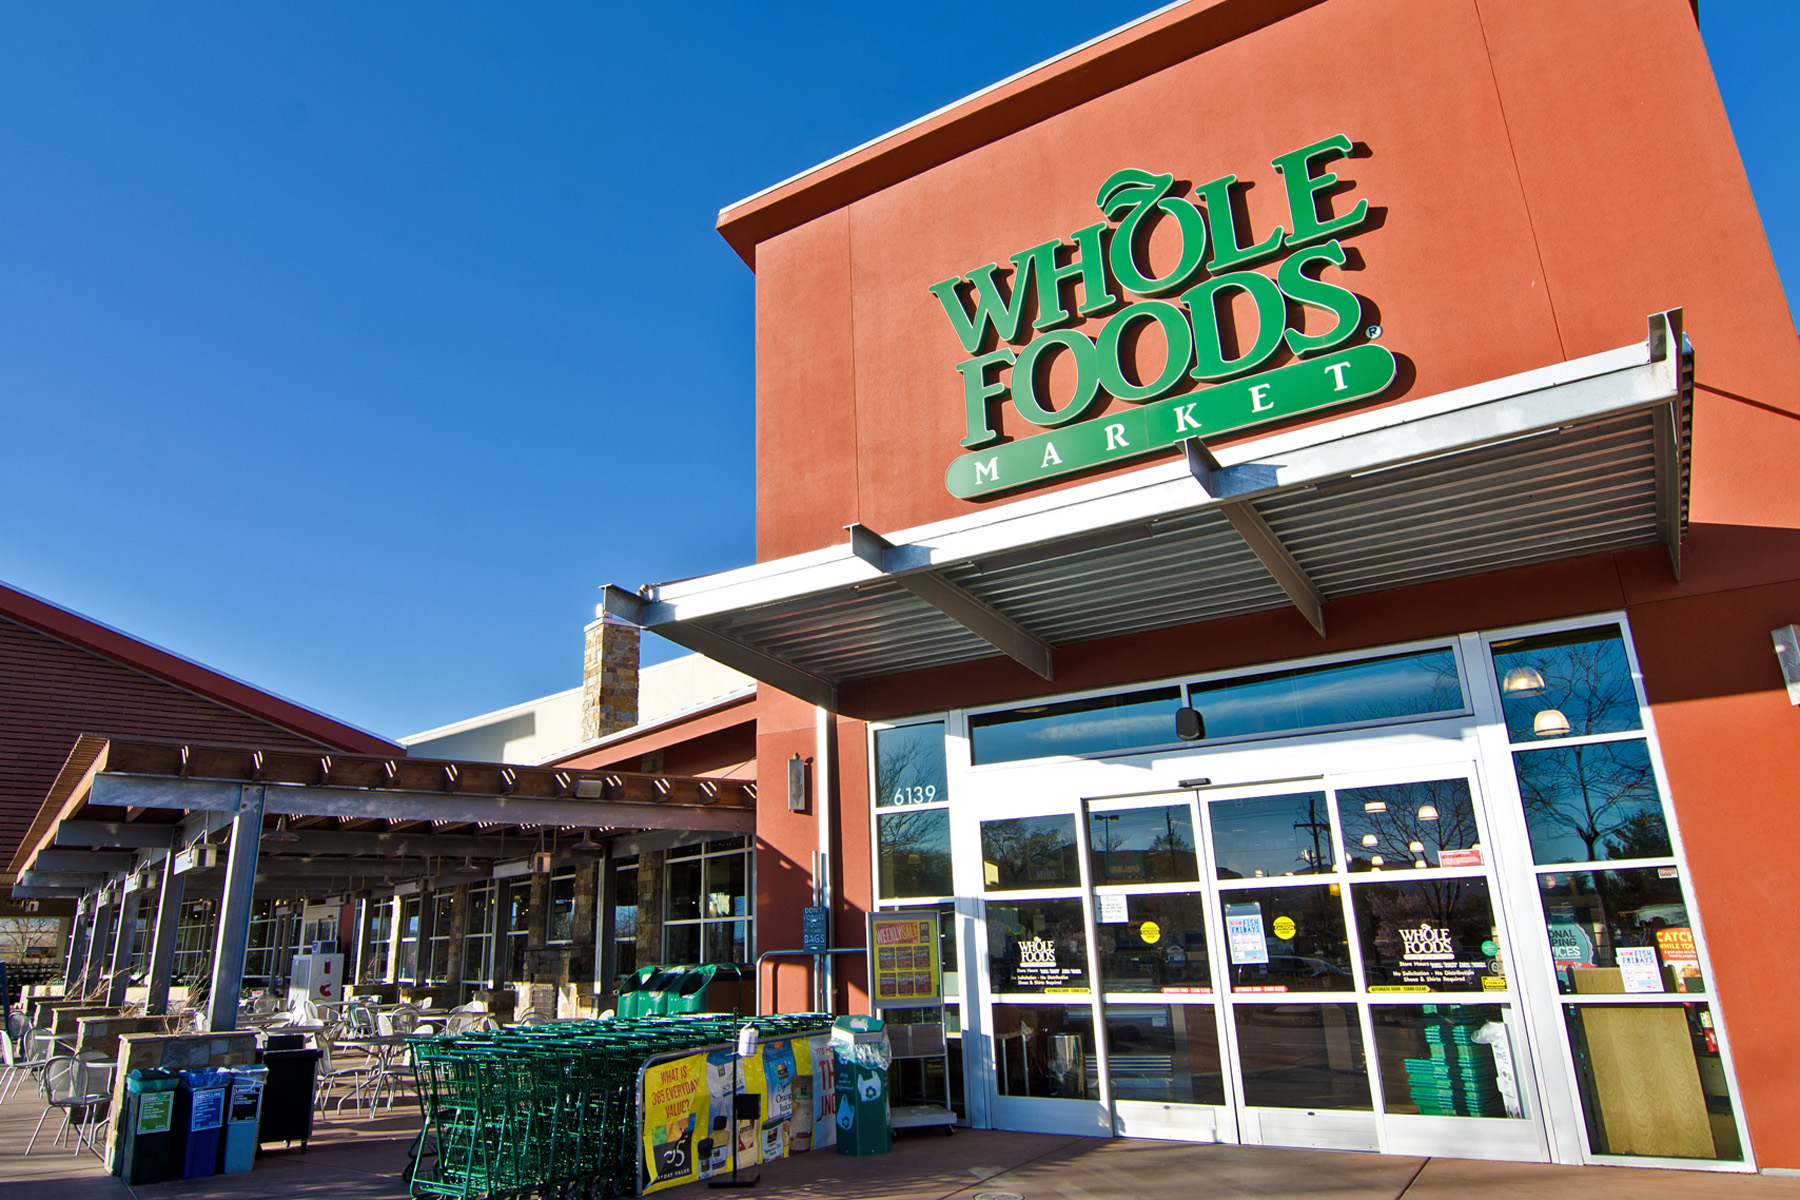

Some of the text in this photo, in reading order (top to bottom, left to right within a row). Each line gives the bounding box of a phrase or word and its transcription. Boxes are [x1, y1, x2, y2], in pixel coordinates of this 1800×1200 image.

[929, 133, 1369, 354] WHOLE
[956, 239, 1362, 449] FOODS
[974, 360, 1352, 486] MARKET
[893, 784, 936, 806] 6139
[1231, 926, 1260, 934] FRIDAYS
[1242, 919, 1259, 927] FISH
[804, 934, 825, 944] BAGS
[875, 922, 918, 945] WEEKLY SALE
[1399, 924, 1452, 941] WHOLE
[1018, 936, 1055, 952] WHOLE
[1404, 940, 1454, 954] FOODS
[1021, 951, 1056, 962] FOODS
[1634, 950, 1652, 958] FISH
[660, 1065, 688, 1085] WHAT IS
[651, 1078, 699, 1106] 365 EVERYDAY
[665, 1098, 691, 1119] VALUE?
[674, 1168, 690, 1176] VALUE
